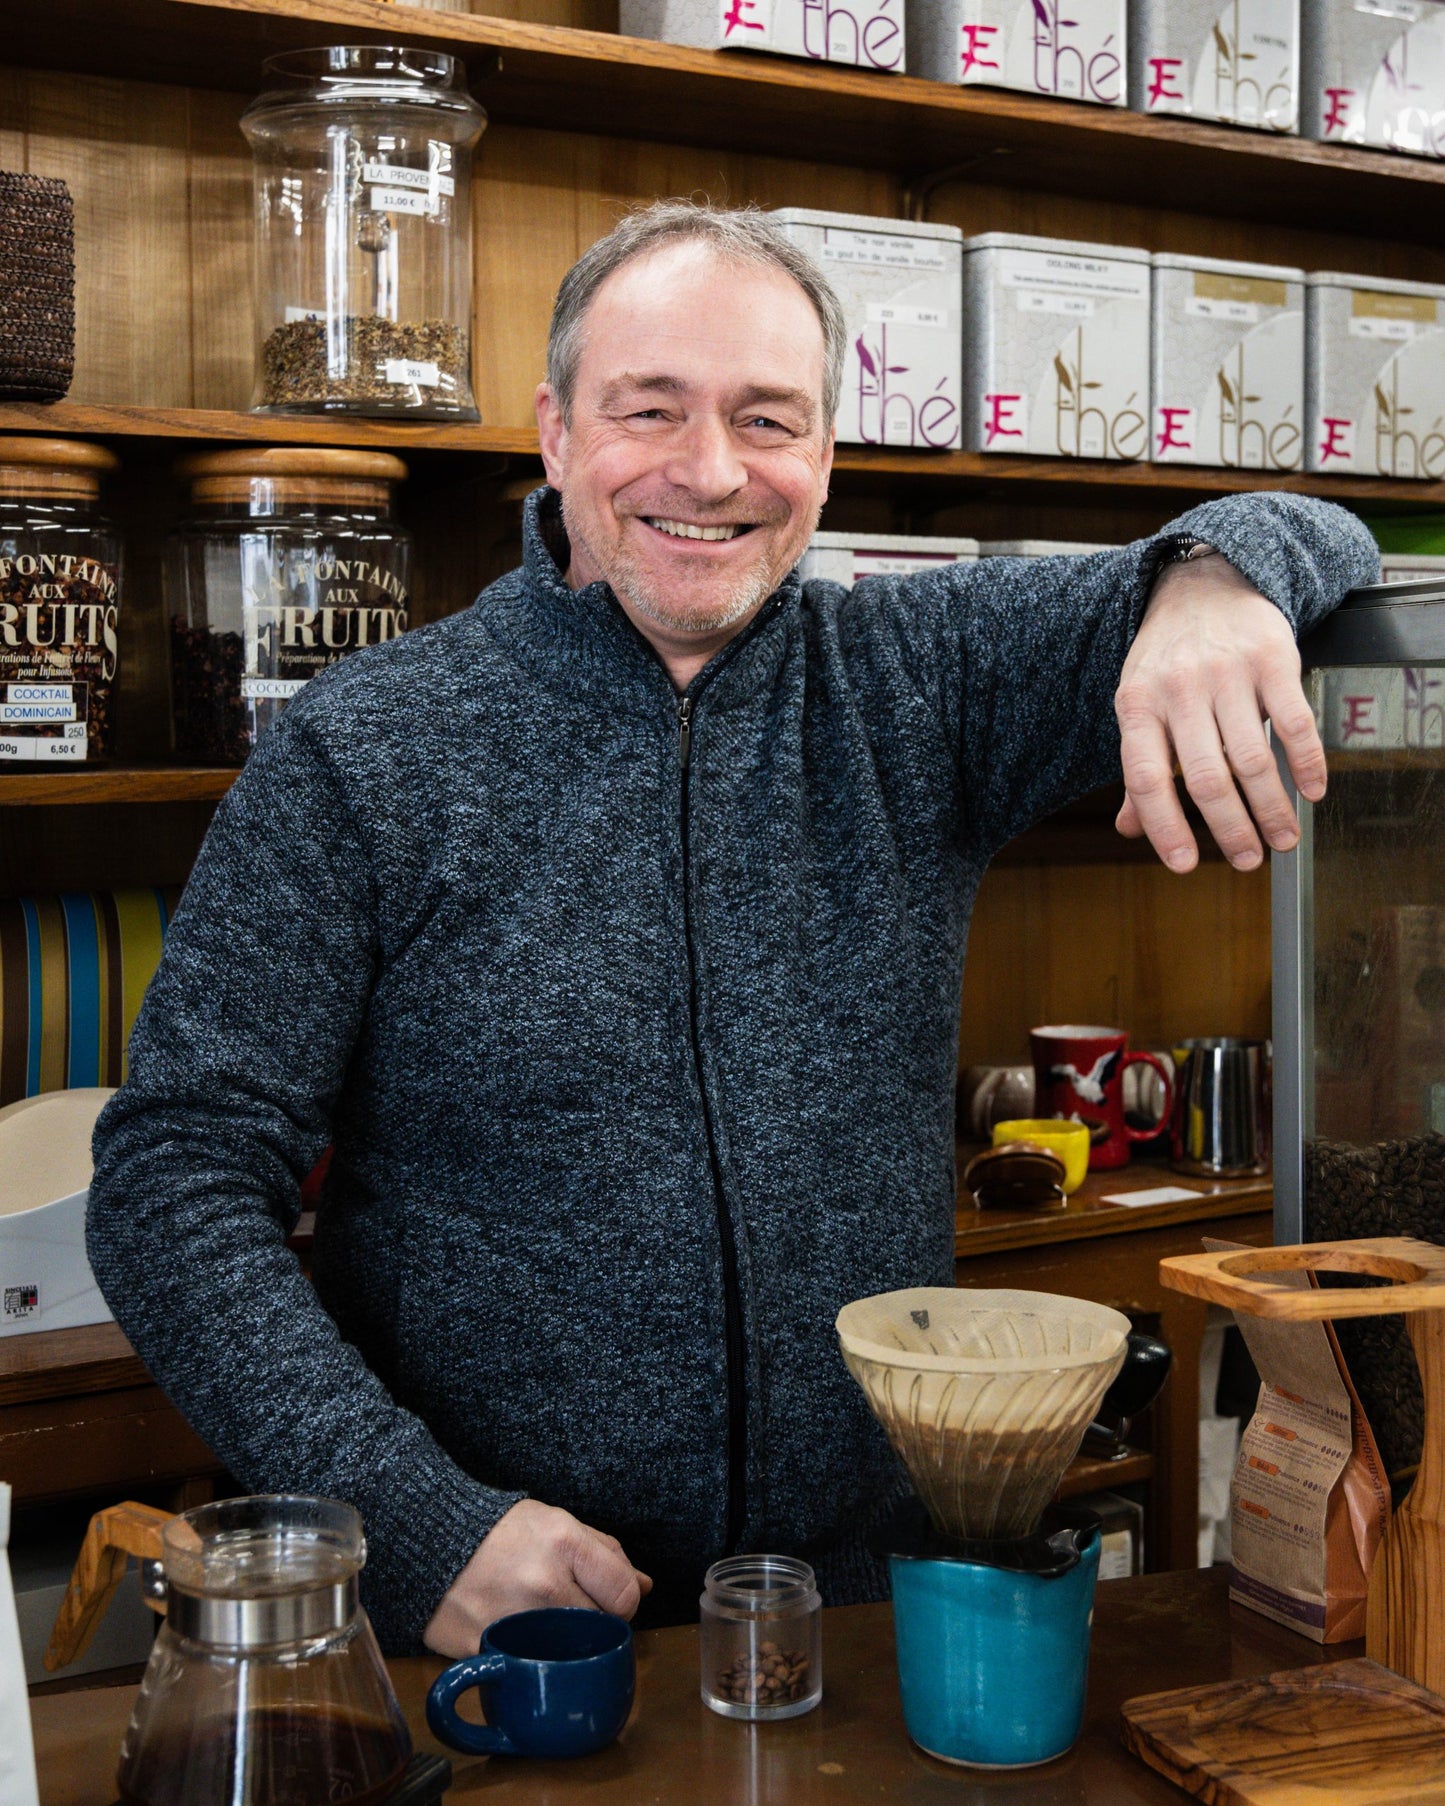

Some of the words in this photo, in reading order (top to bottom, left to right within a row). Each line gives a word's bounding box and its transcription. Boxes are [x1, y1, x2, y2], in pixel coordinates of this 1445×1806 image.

[1032, 0, 1121, 104] thé
[856, 322, 960, 447] thé
[1055, 325, 1148, 459] thé
[1217, 340, 1301, 469] thé
[28, 583, 65, 599] AUX
[295, 559, 408, 608] FONTAINE
[324, 588, 360, 604] AUX
[14, 688, 70, 700] COCKTAIL
[249, 682, 302, 694] COCKTAI
[4, 707, 72, 718] DOMINICAIN
[68, 727, 84, 738] 250
[50, 745, 69, 755] 6,50
[70, 744, 76, 754] €
